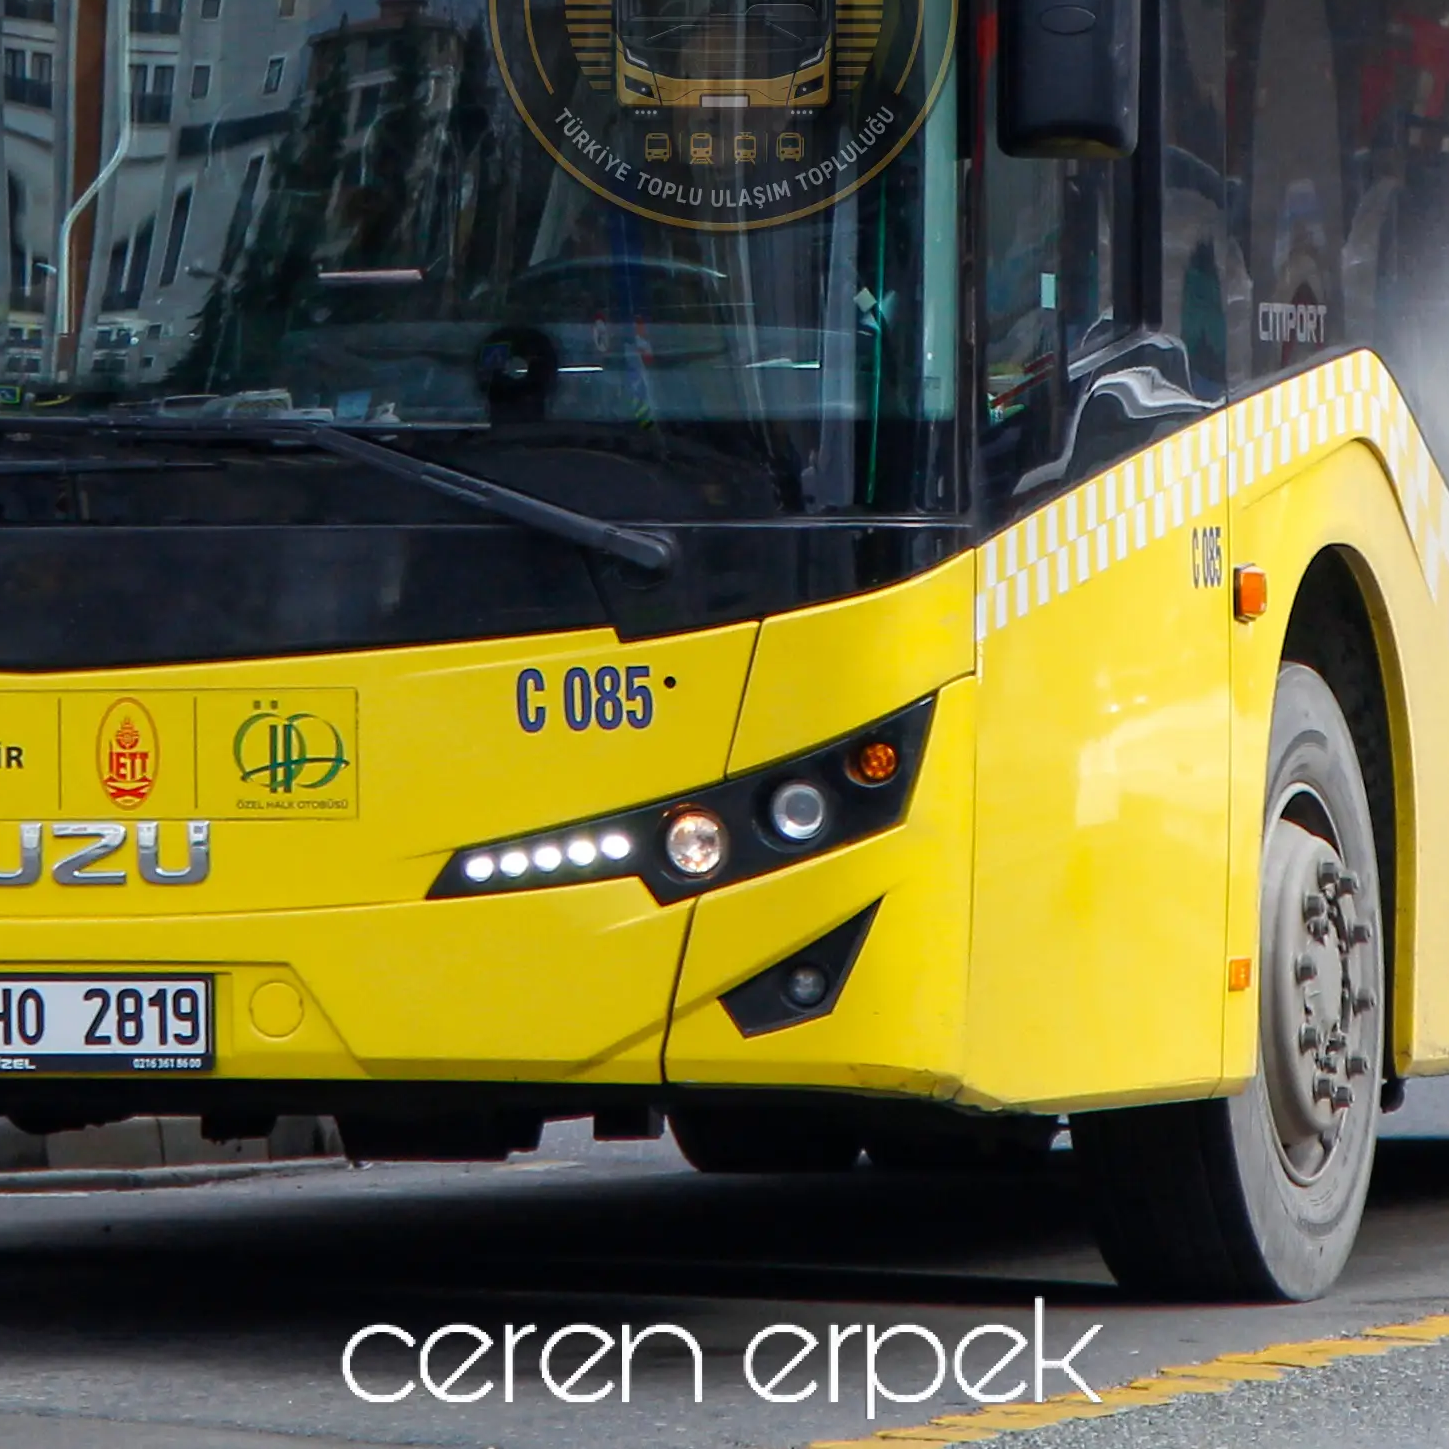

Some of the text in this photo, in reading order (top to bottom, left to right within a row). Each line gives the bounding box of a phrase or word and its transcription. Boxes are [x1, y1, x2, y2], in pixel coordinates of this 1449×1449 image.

[1258, 302, 1328, 343] CITIPORT
[1191, 526, 1223, 589] C 085
[517, 665, 653, 733] C 085
[83, 987, 201, 1047] 2819
